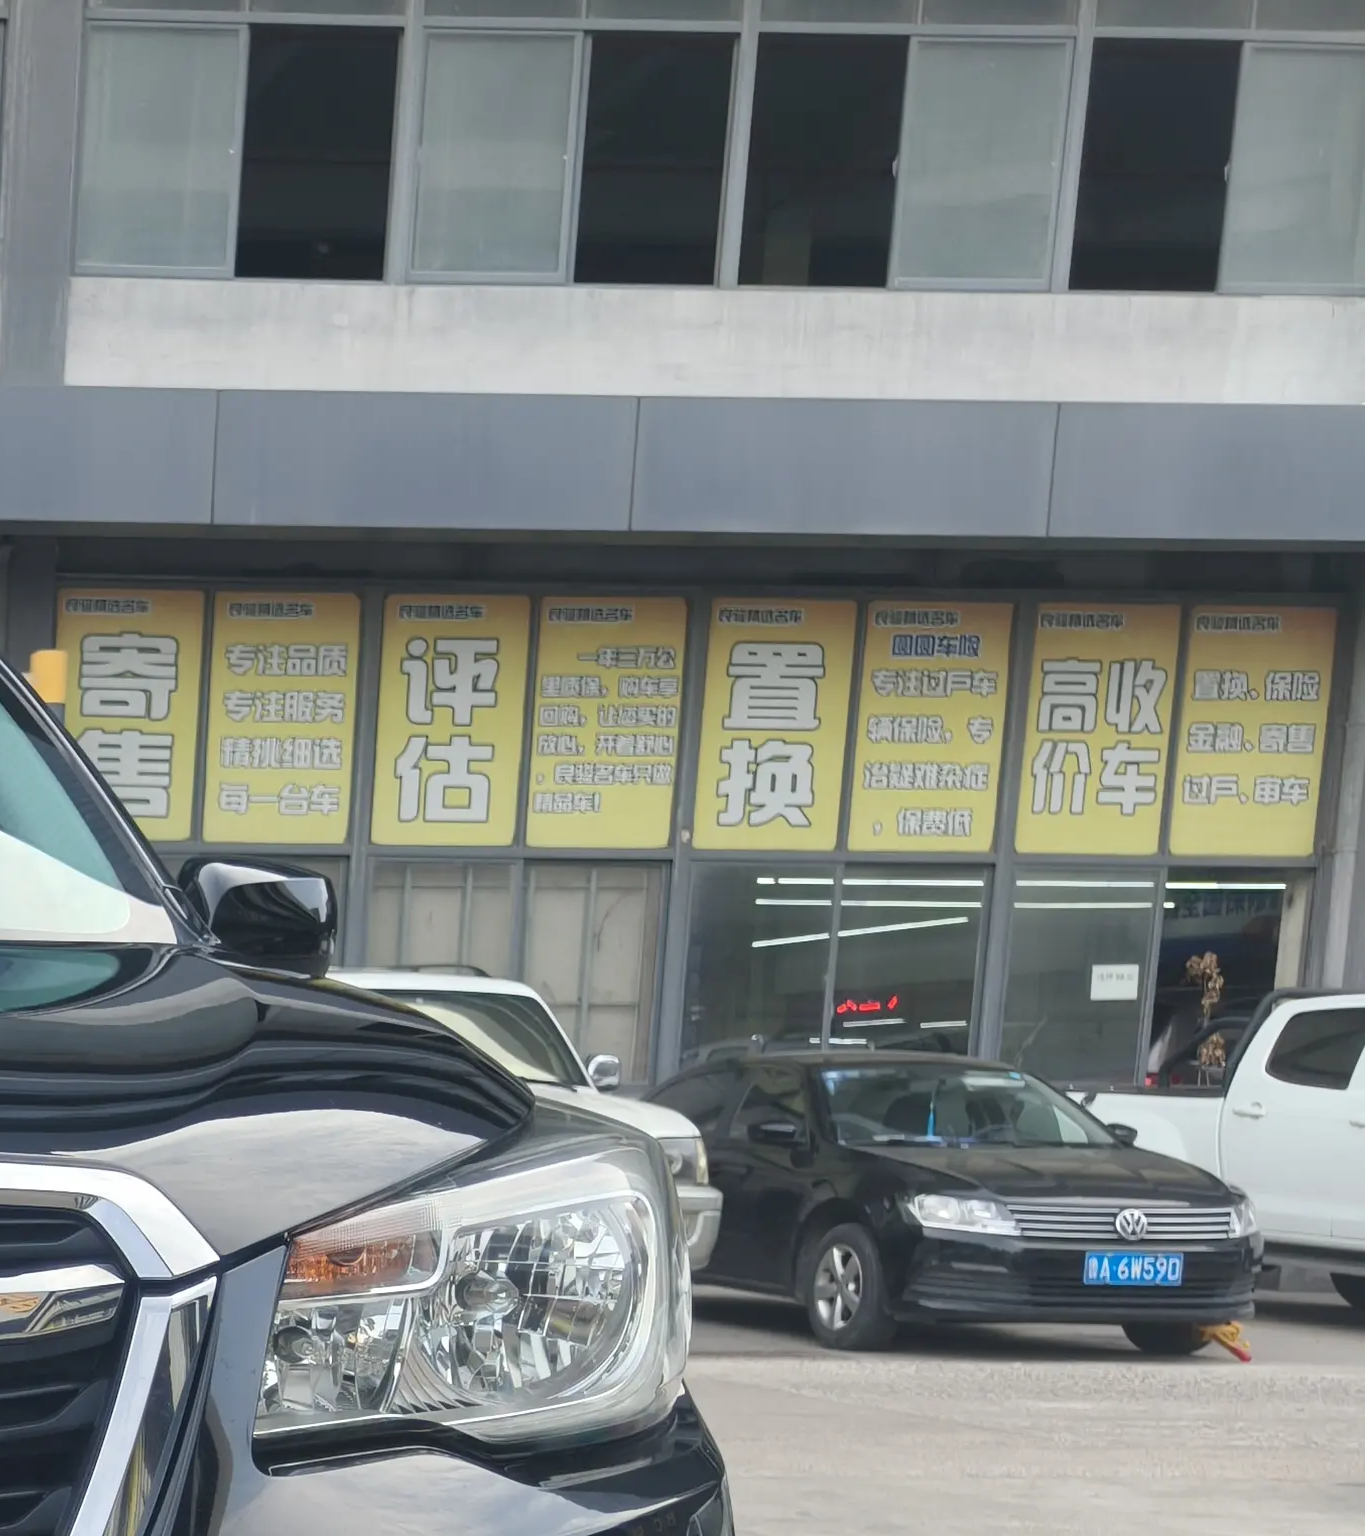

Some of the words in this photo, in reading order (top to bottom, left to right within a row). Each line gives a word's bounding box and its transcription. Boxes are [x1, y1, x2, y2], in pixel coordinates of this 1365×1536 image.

[225, 644, 348, 677] 专注品质
[871, 668, 998, 698] 专注过户车
[223, 690, 346, 723] 专注服务
[76, 631, 179, 818] 寄售
[395, 636, 500, 823] 评估
[716, 640, 825, 827] 置换
[220, 736, 343, 770] 精挑细选
[219, 783, 342, 816] 每一台车
